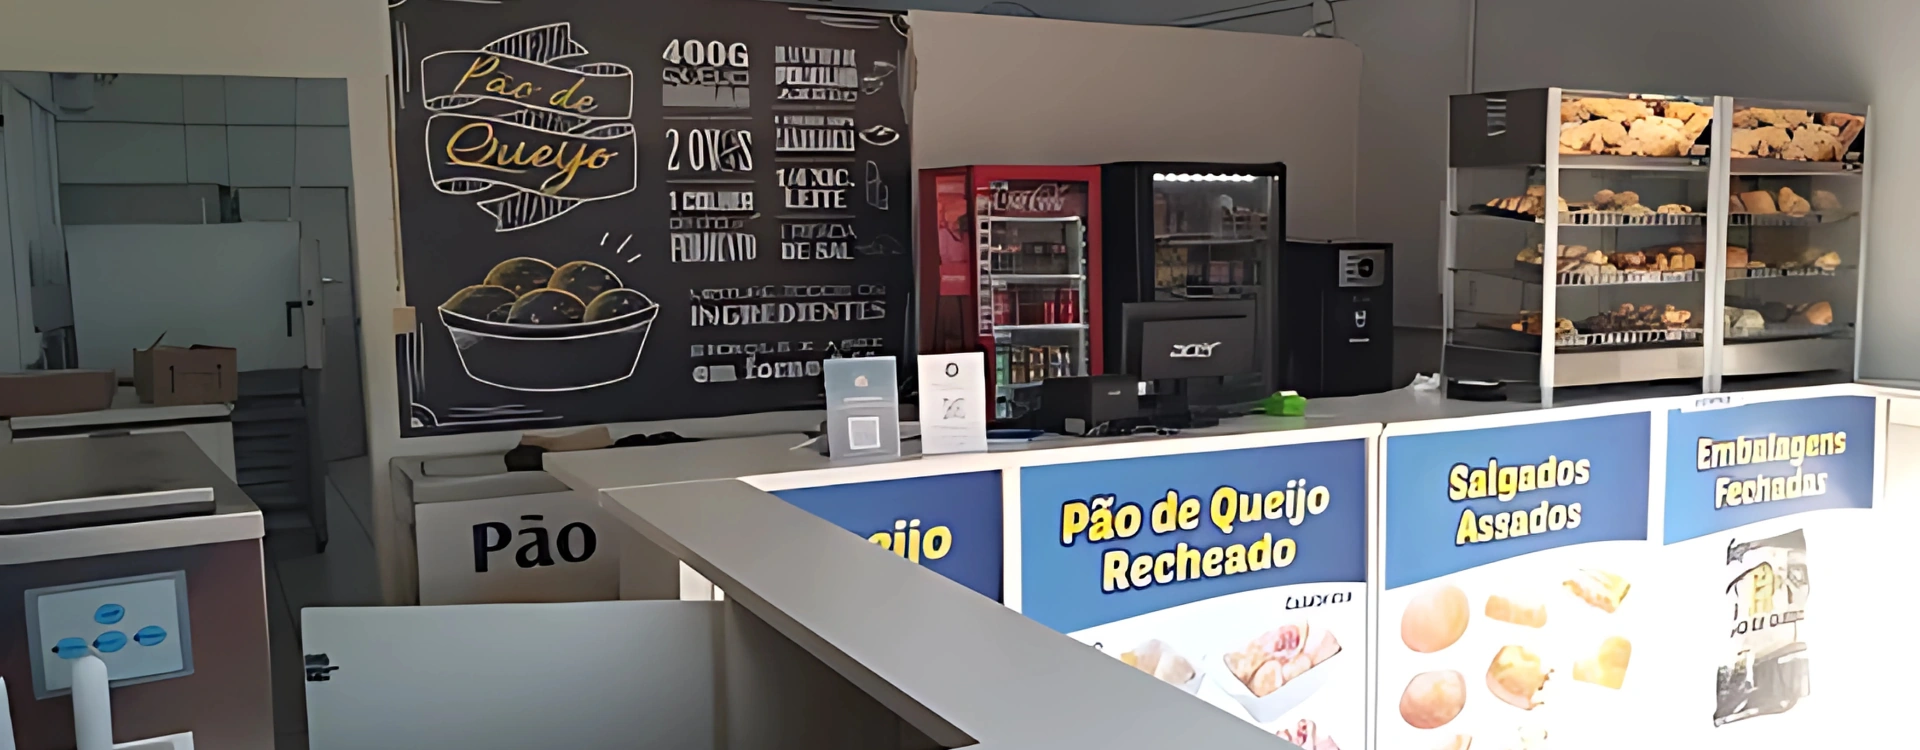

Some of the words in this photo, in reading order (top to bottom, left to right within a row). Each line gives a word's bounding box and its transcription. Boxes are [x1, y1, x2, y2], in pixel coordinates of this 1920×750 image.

[663, 39, 749, 67] 400G
[454, 56, 541, 99] Pão
[549, 77, 599, 113] de
[666, 128, 680, 171] 2
[785, 187, 847, 208] LEITE
[782, 242, 810, 259] DE
[1697, 431, 1847, 470] Embalagens
[1448, 457, 1590, 501] Salgados
[1060, 494, 1143, 546] Pão
[1151, 489, 1202, 534] de
[1210, 478, 1331, 534] Queijo
[1455, 501, 1581, 546] Assados
[1102, 532, 1298, 594] Recheado
